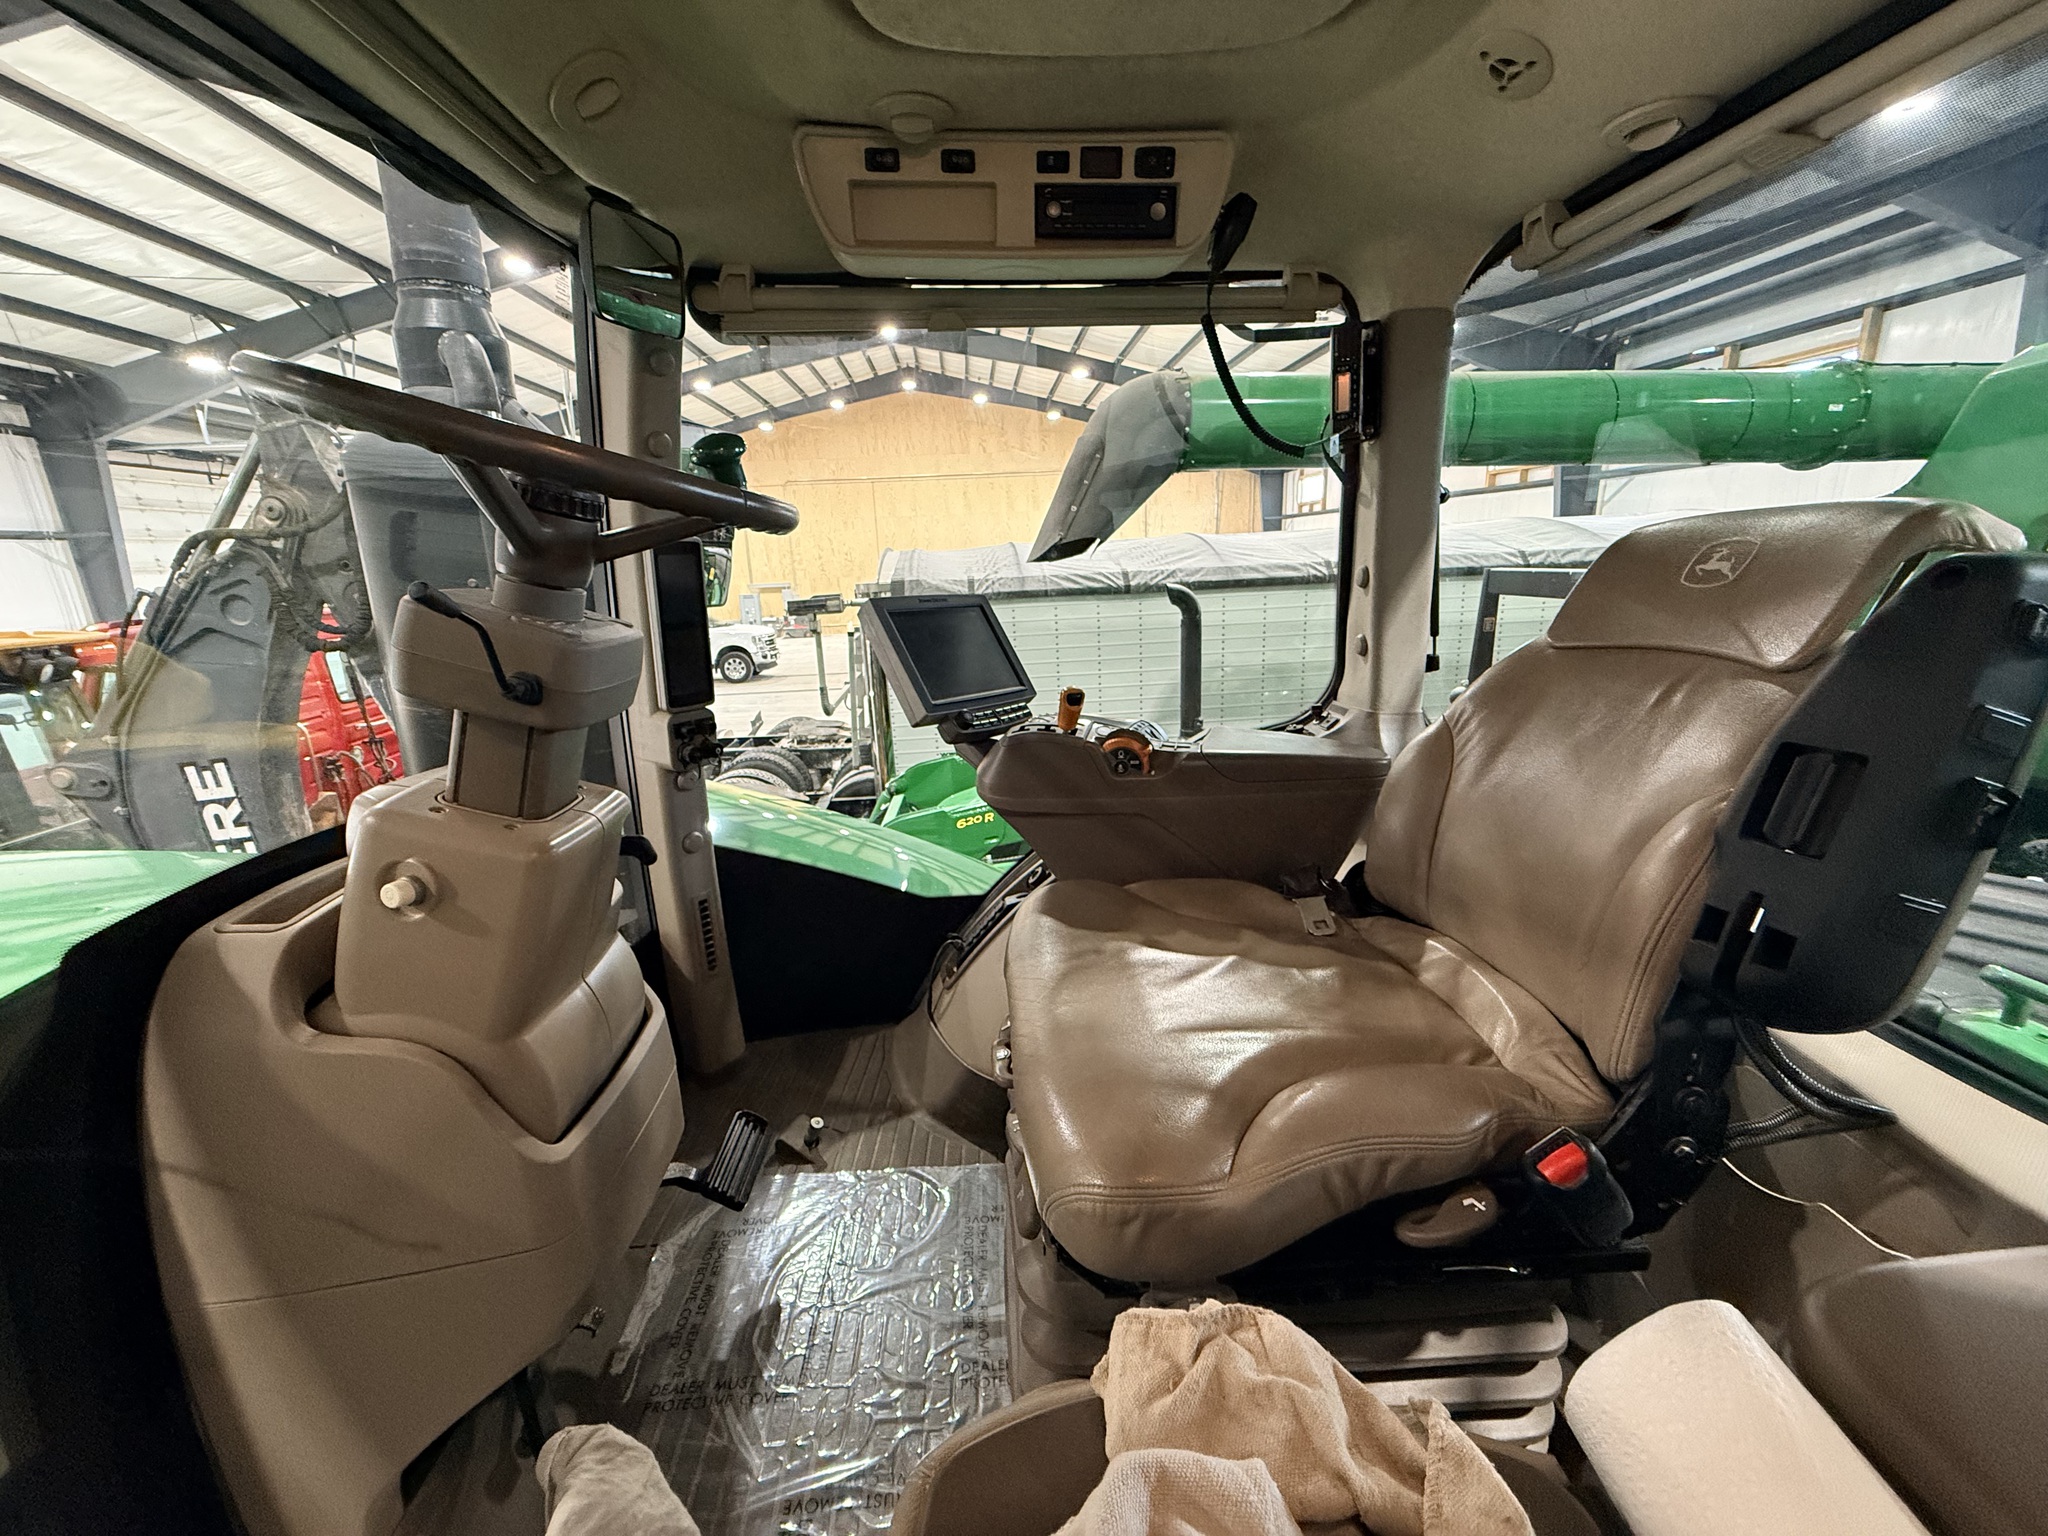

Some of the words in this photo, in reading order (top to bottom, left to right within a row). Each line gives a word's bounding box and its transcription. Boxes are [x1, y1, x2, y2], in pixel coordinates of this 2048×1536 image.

[183, 762, 258, 853] RE
[696, 1283, 717, 1316] MUST
[669, 1307, 693, 1348] COVER
[961, 1358, 1010, 1374] DEALE
[648, 1379, 705, 1397] DEALER
[713, 1376, 757, 1391] MUST
[863, 1492, 901, 1510] UST
